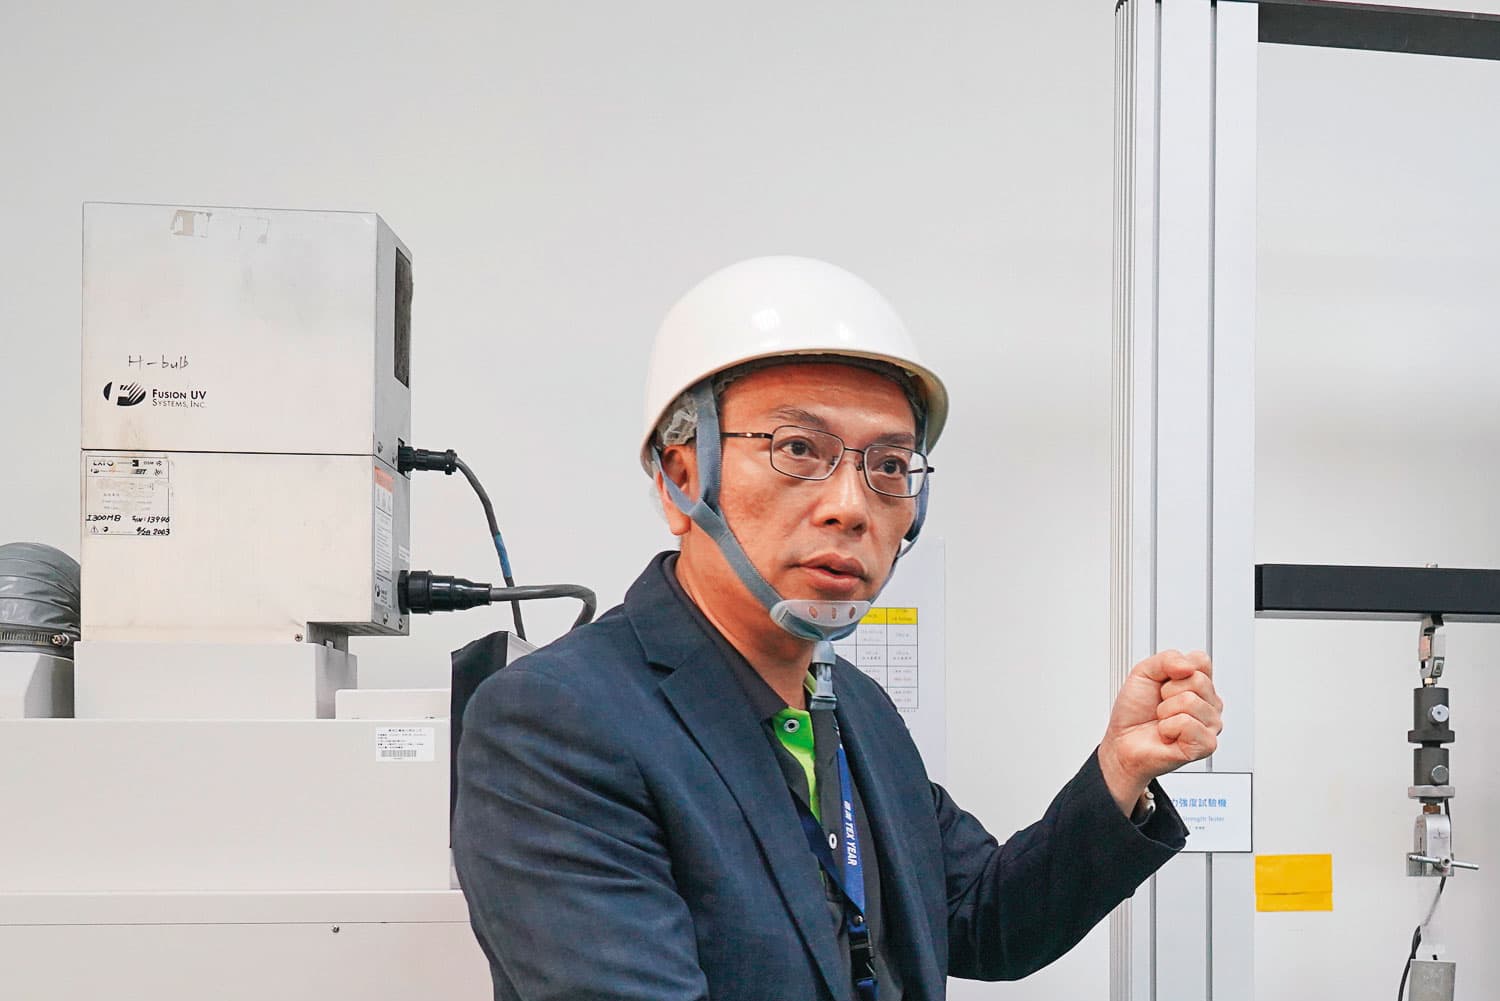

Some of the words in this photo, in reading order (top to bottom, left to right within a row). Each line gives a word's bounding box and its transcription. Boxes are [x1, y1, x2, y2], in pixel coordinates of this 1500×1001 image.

[190, 390, 207, 400] UV
[845, 822, 856, 840] TEX
[846, 841, 858, 866] YEAR
